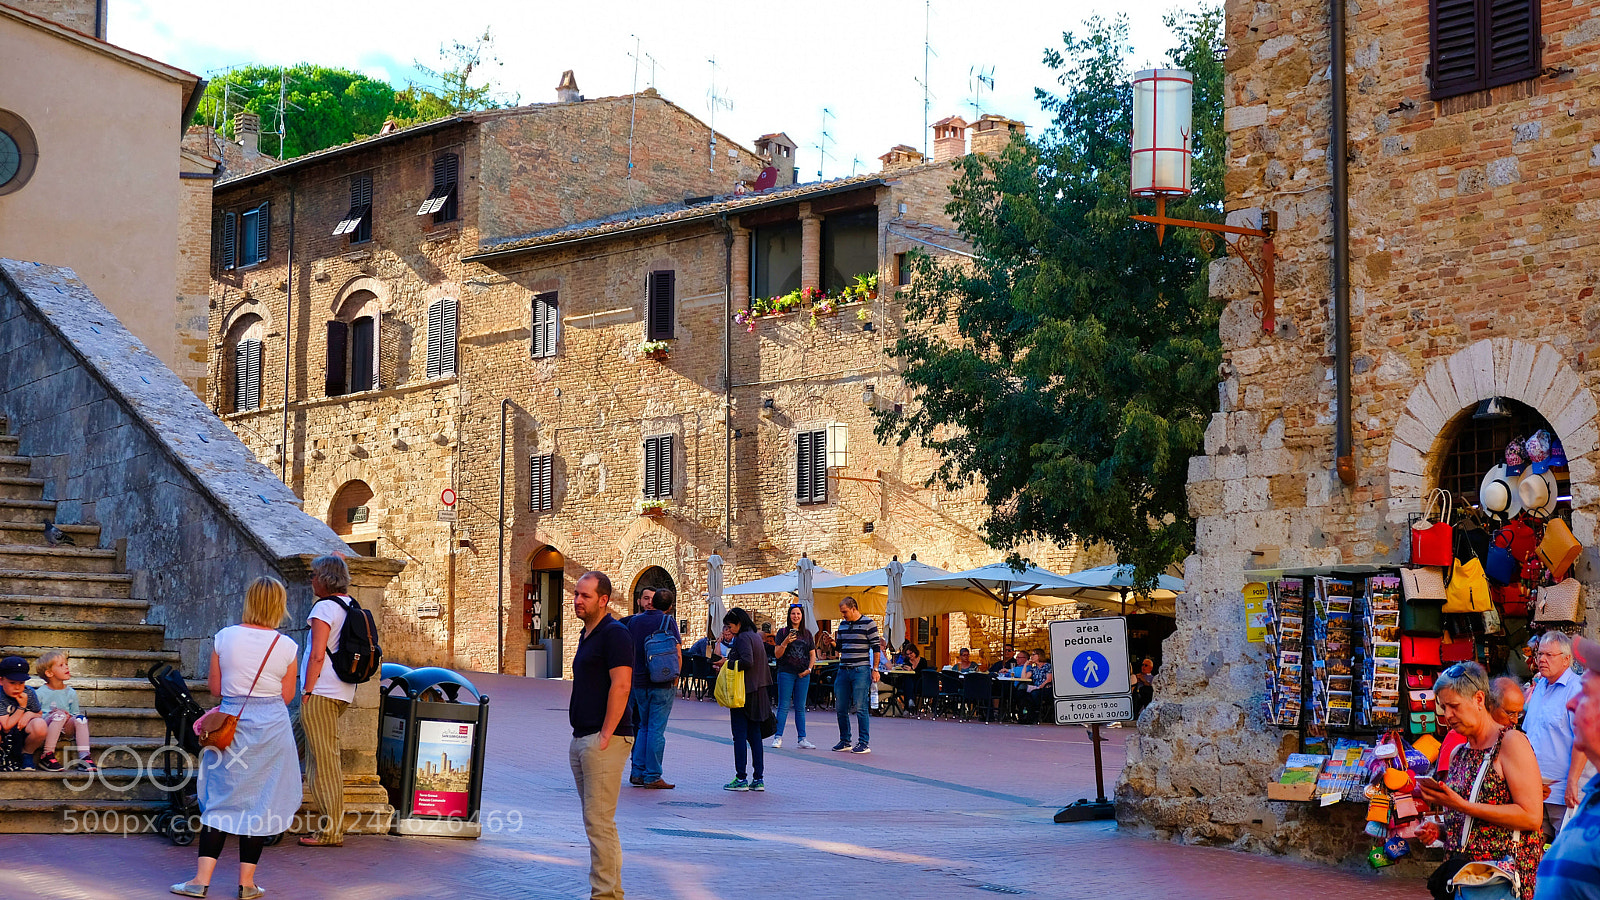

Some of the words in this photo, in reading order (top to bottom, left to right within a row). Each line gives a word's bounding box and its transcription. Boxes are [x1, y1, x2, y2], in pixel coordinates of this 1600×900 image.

[1076, 625, 1099, 633] area
[1064, 635, 1113, 647] pedonale
[1073, 712, 1095, 720] 01/06
[1106, 710, 1129, 718] 30/09
